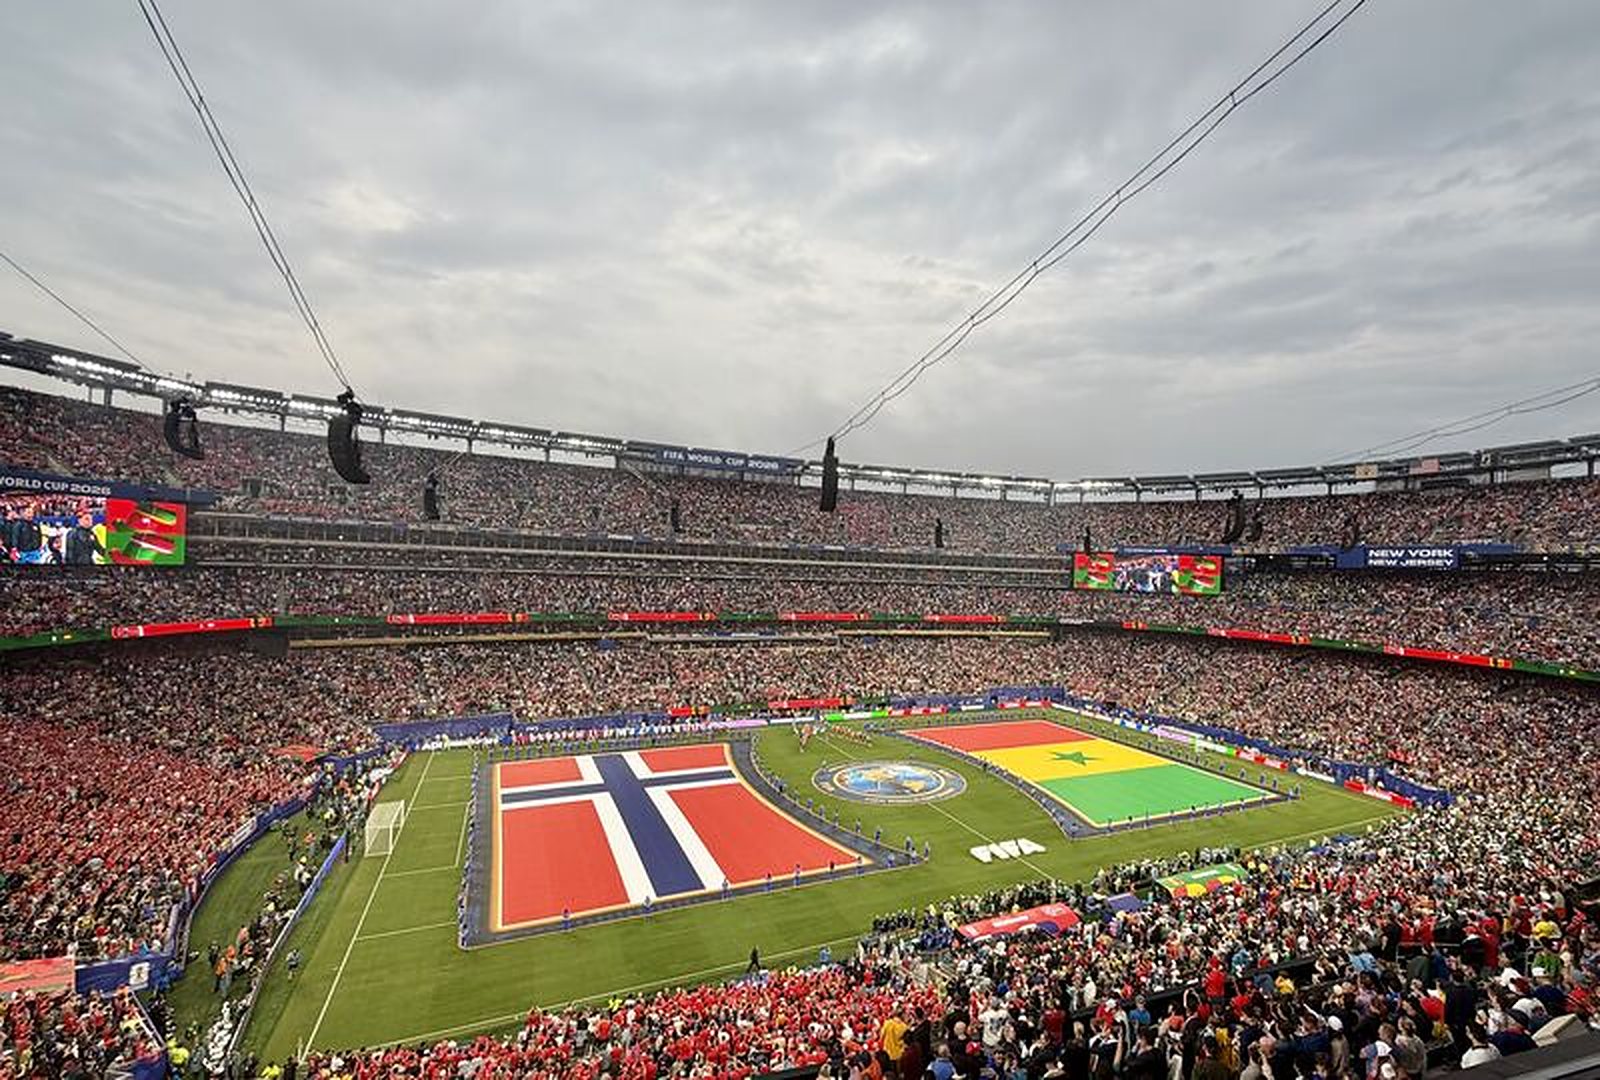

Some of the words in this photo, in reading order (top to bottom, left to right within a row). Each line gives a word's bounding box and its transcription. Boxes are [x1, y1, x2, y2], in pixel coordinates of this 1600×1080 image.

[663, 450, 686, 460] FIFA
[687, 453, 722, 465] WORLD
[725, 457, 745, 466] CUP
[43, 481, 69, 491] CUP
[70, 483, 112, 495] 2026
[1368, 549, 1405, 558] NEW
[1407, 549, 1455, 558] YORK
[1367, 559, 1398, 567] NEW
[1399, 559, 1454, 568] JERSEY
[969, 838, 1047, 864] FIFA
